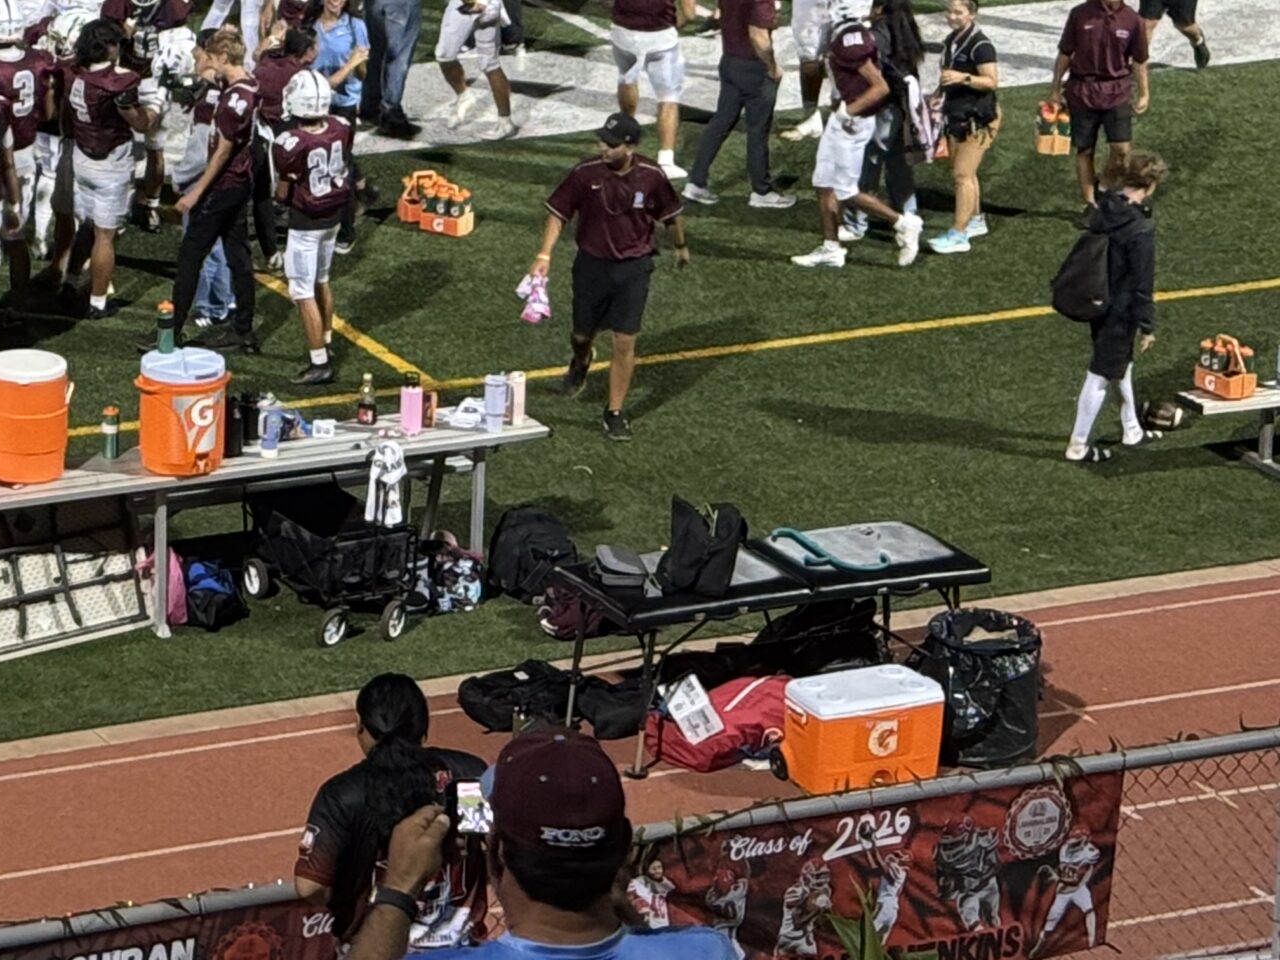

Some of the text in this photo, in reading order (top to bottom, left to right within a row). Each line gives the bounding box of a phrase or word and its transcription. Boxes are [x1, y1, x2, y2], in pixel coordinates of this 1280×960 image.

[12, 70, 36, 118] 3
[70, 78, 93, 124] 4
[306, 140, 348, 199] 24
[431, 218, 445, 232] G
[1204, 375, 1216, 390] G
[190, 397, 215, 427] G
[868, 718, 899, 758] G
[729, 807, 912, 862] Class of 2026
